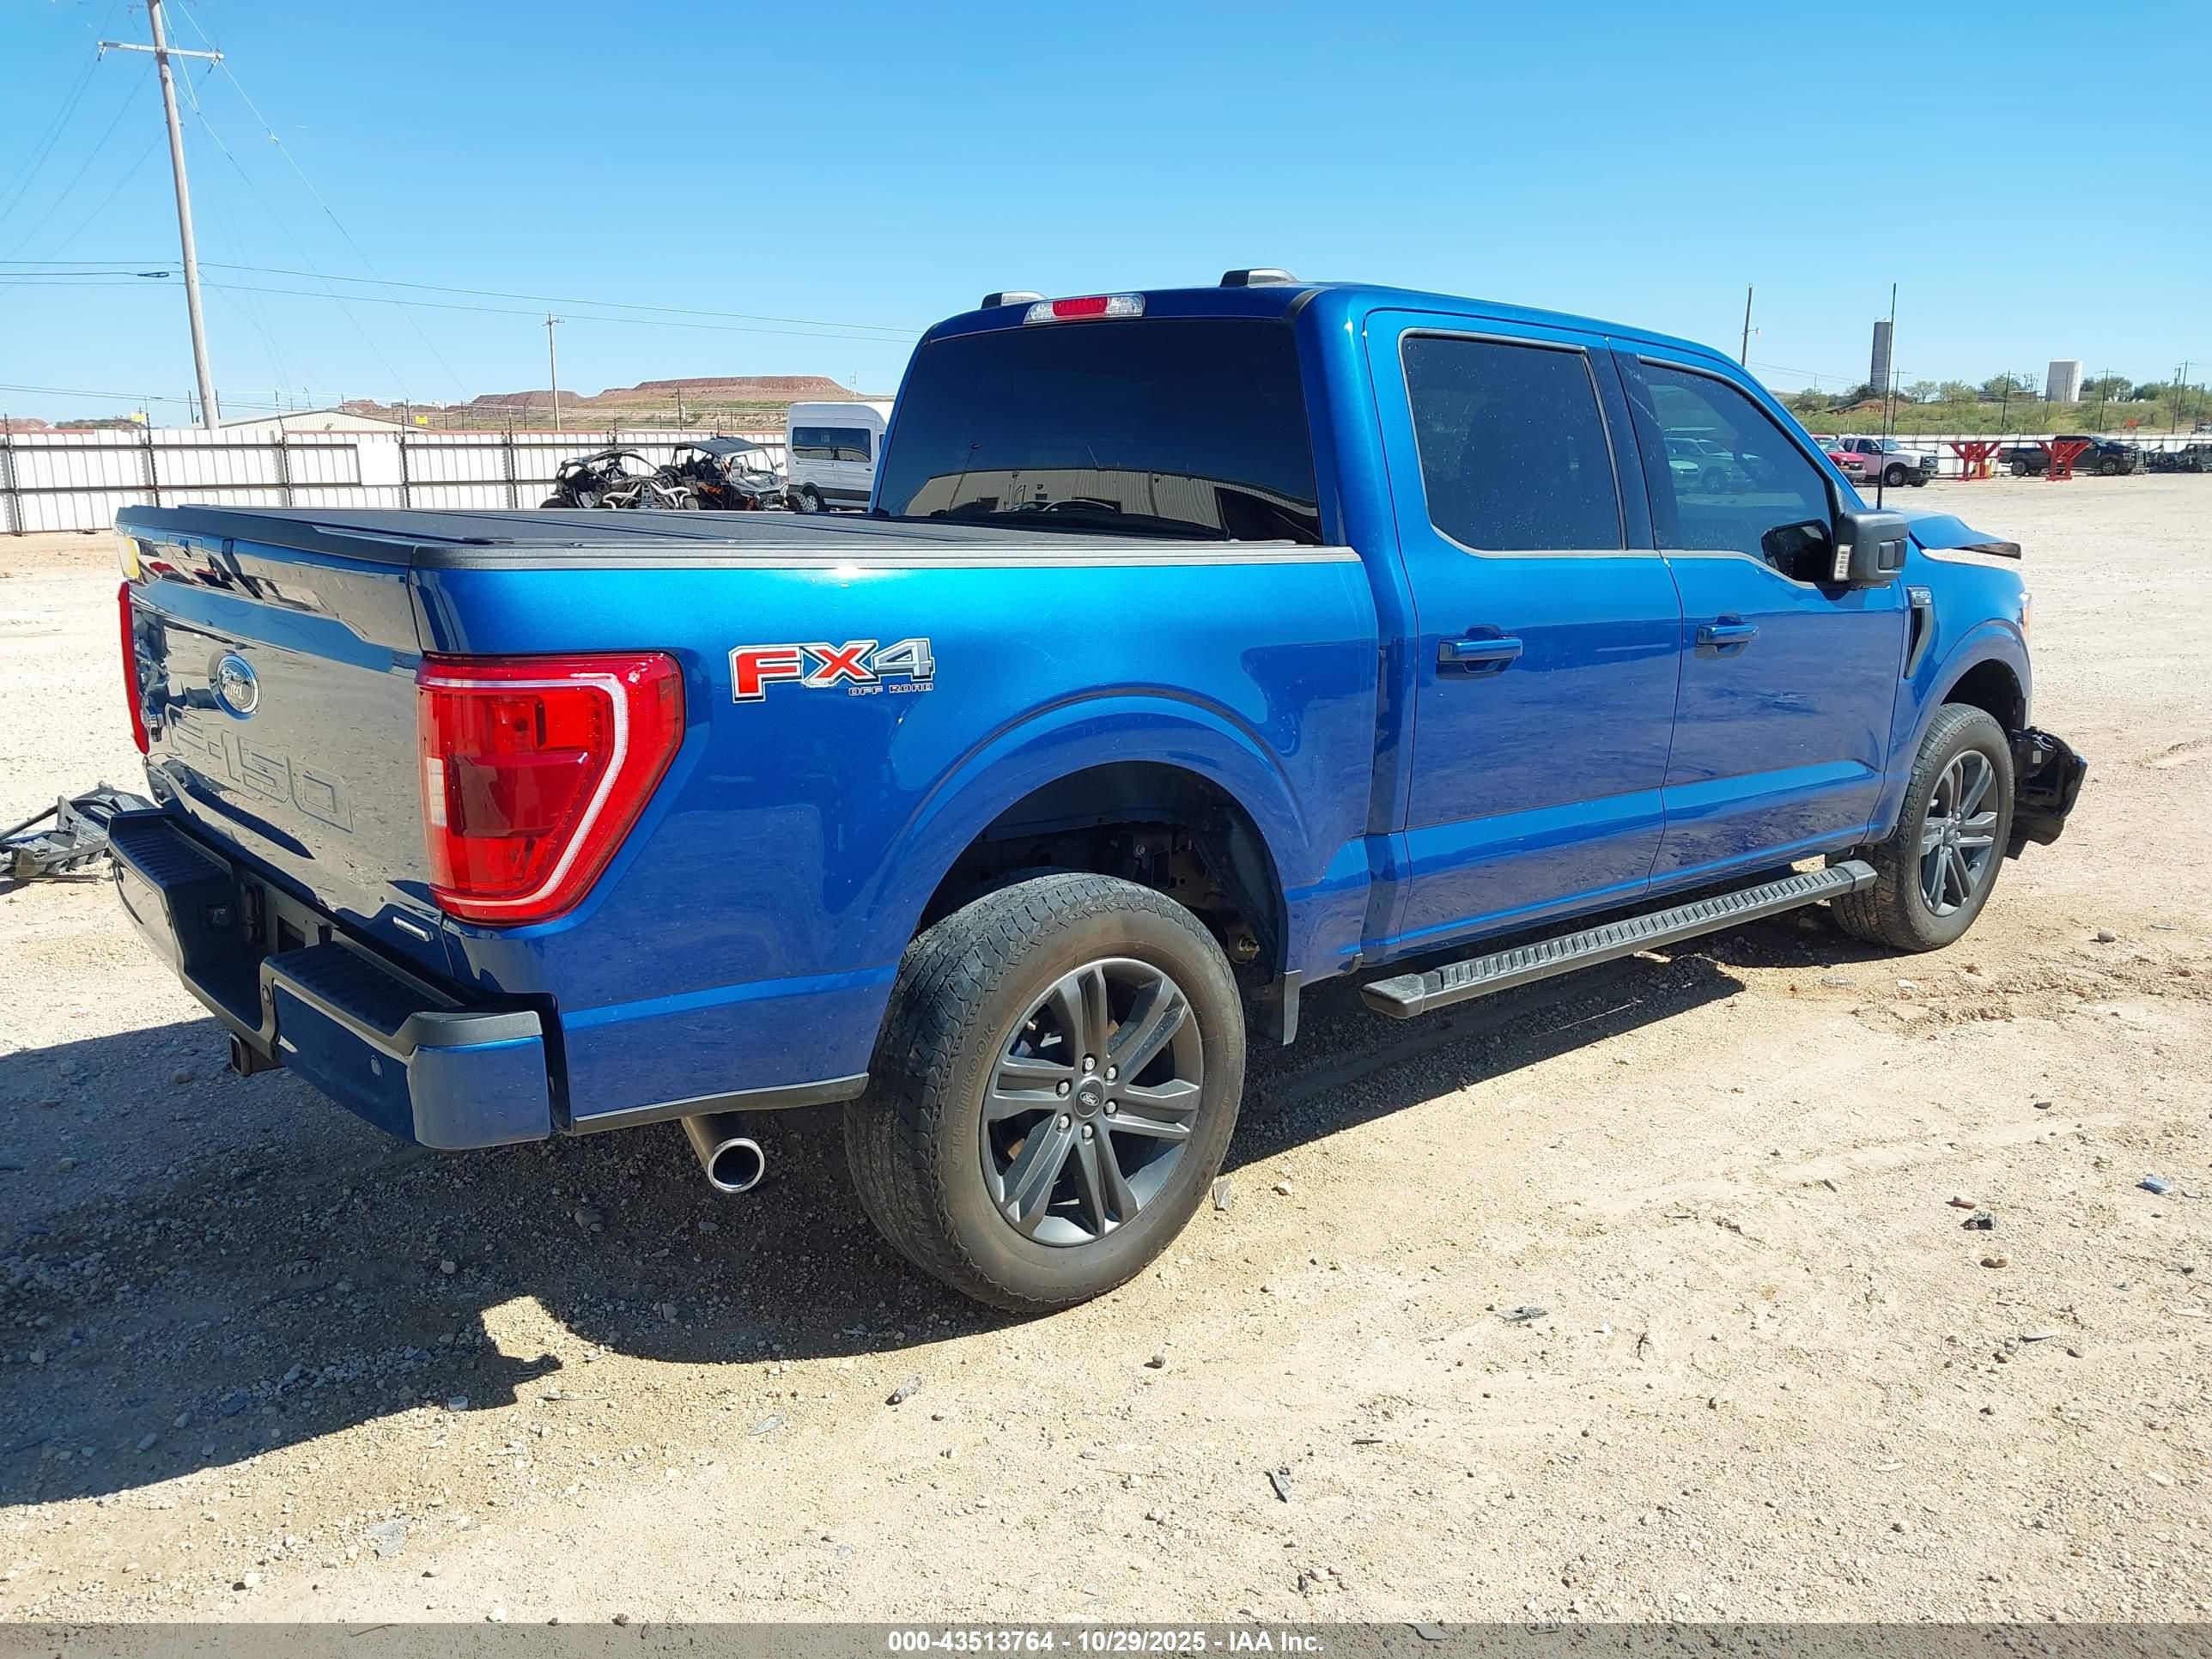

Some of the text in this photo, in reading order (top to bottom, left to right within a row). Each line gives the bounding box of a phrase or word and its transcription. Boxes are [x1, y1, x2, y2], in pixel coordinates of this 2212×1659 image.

[729, 638, 935, 703] FX4
[848, 683, 934, 696] OFF ROAD
[165, 702, 353, 834] F-150
